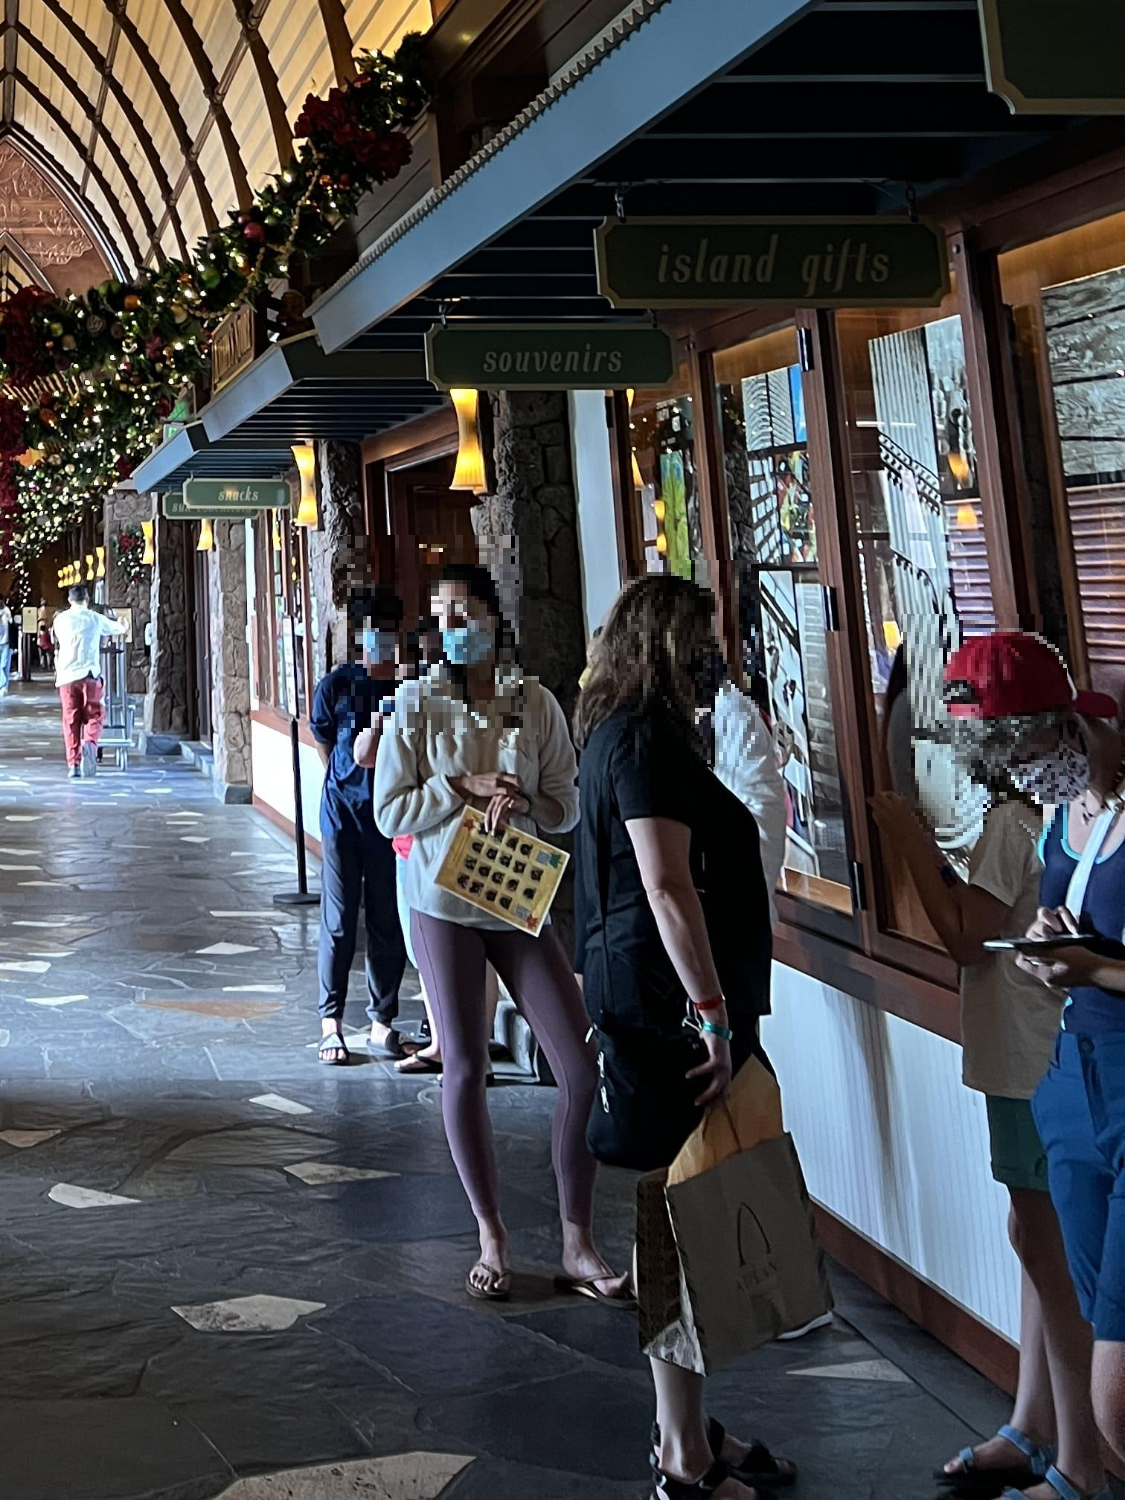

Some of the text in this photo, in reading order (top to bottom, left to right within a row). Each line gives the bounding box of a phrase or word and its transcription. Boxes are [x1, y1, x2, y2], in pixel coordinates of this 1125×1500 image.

[658, 233, 890, 297] island gifts
[483, 343, 622, 373] souvenirs
[218, 486, 259, 501] snacks
